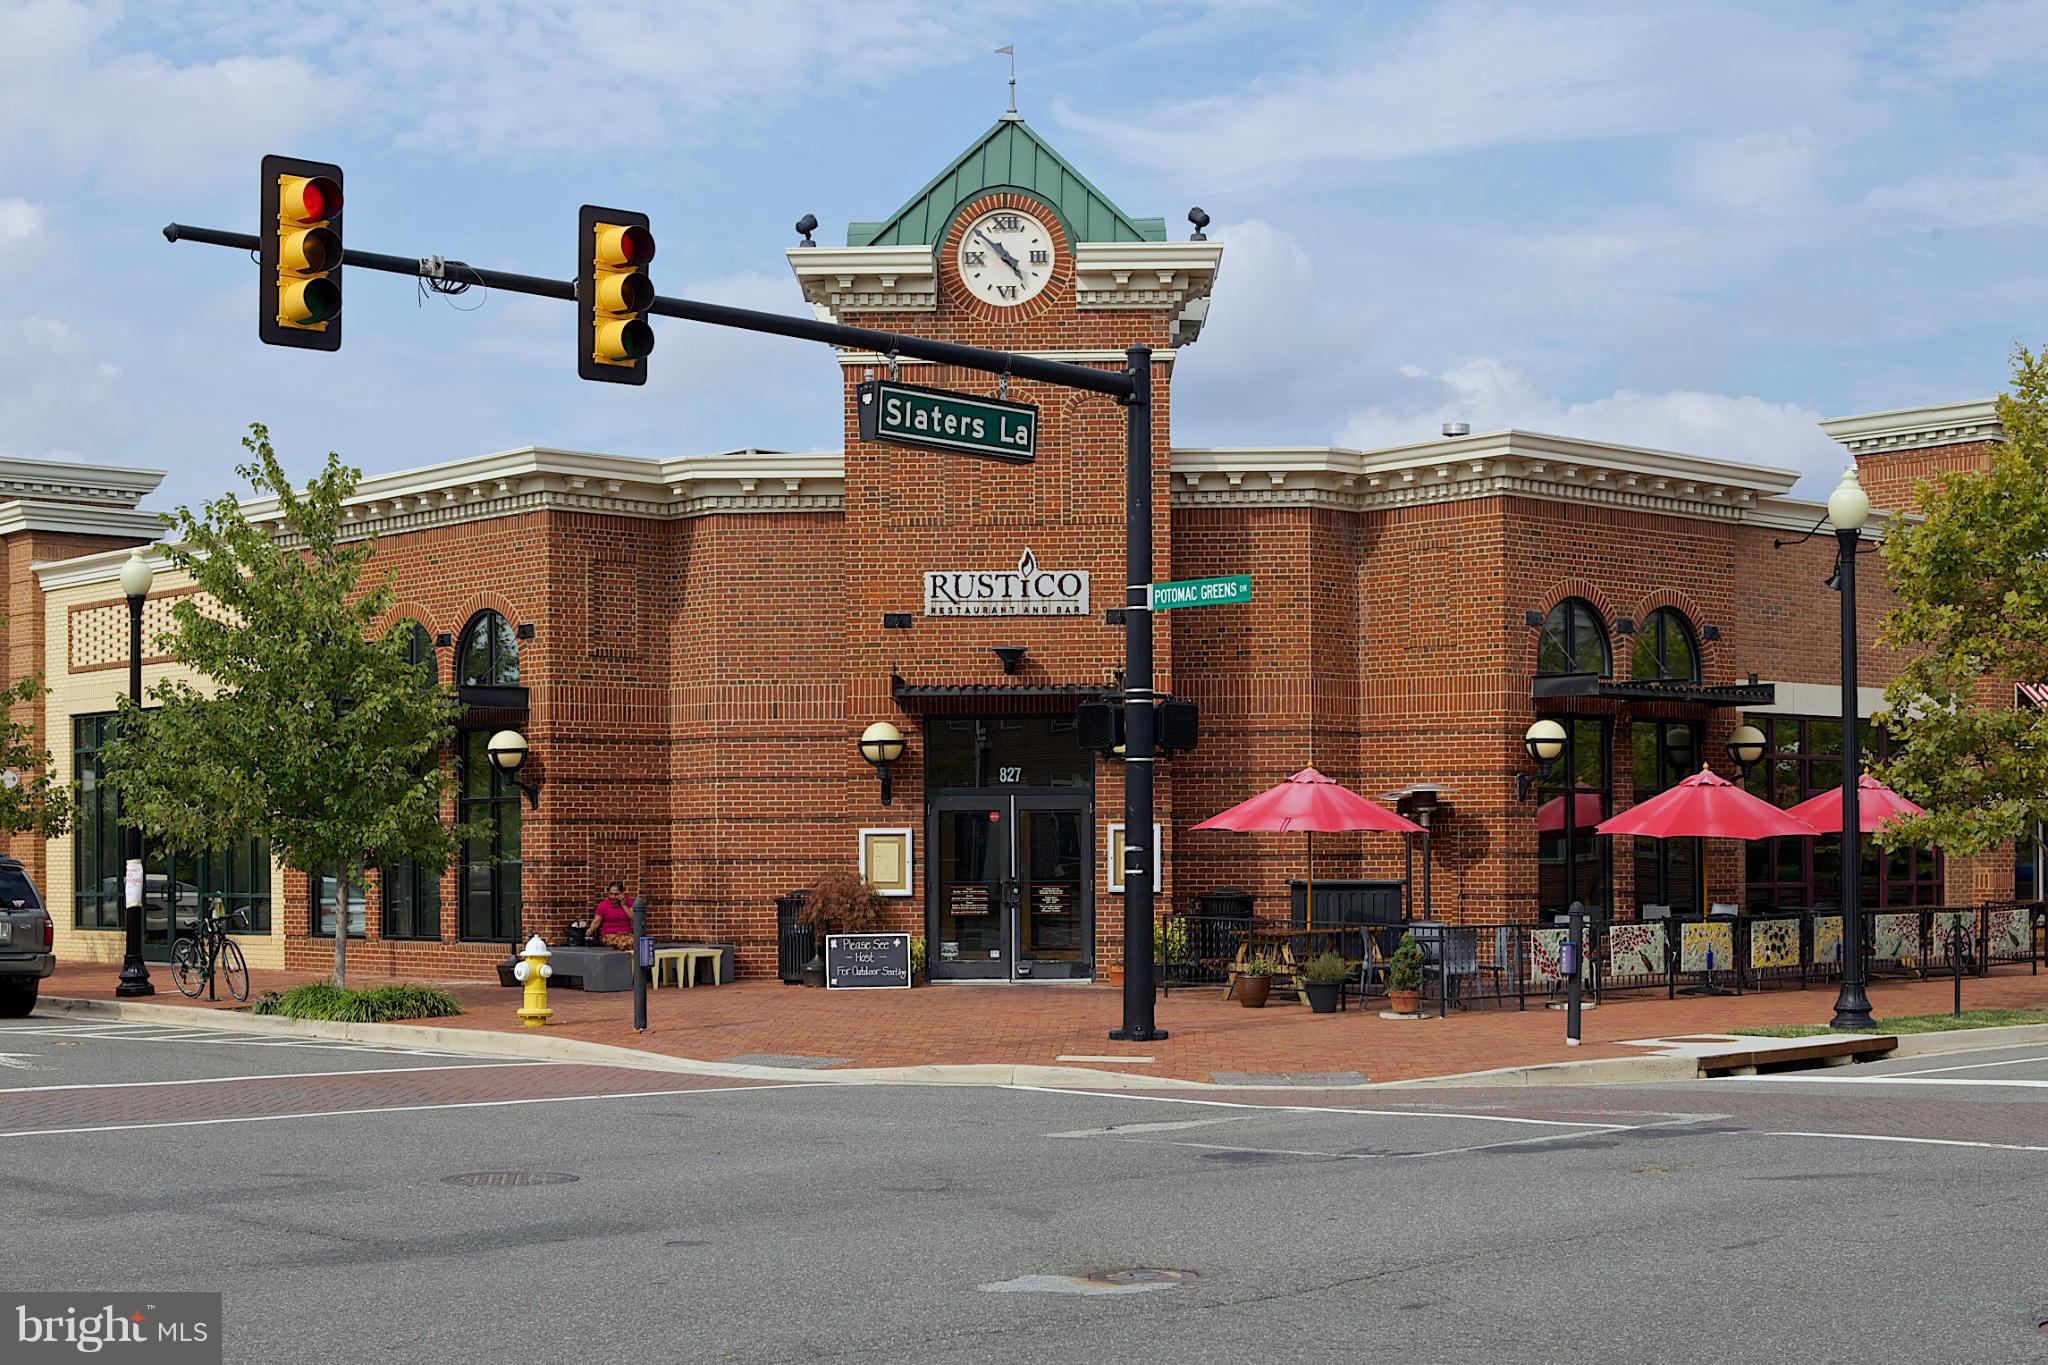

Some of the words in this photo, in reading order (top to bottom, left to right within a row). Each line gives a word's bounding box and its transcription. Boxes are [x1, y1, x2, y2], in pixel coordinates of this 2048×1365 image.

[992, 216, 1018, 230] XII
[964, 251, 985, 265] IX
[1029, 250, 1048, 263] III
[996, 286, 1017, 298] VI
[886, 398, 985, 439] Slaters
[1000, 416, 1028, 446] La
[930, 573, 1082, 604] RUSTICO
[1154, 586, 1198, 604] POTOMAC
[1200, 582, 1237, 600] GREENS
[930, 606, 1015, 614] RESTAURANT
[1024, 606, 1048, 614] AND
[1056, 606, 1080, 614] BAR
[1000, 766, 1022, 782] 827
[843, 938, 871, 950] Please
[873, 938, 890, 950] See
[855, 952, 874, 963] Host
[837, 966, 851, 976] For
[852, 965, 881, 976] Outdoor
[882, 966, 907, 979] Seating
